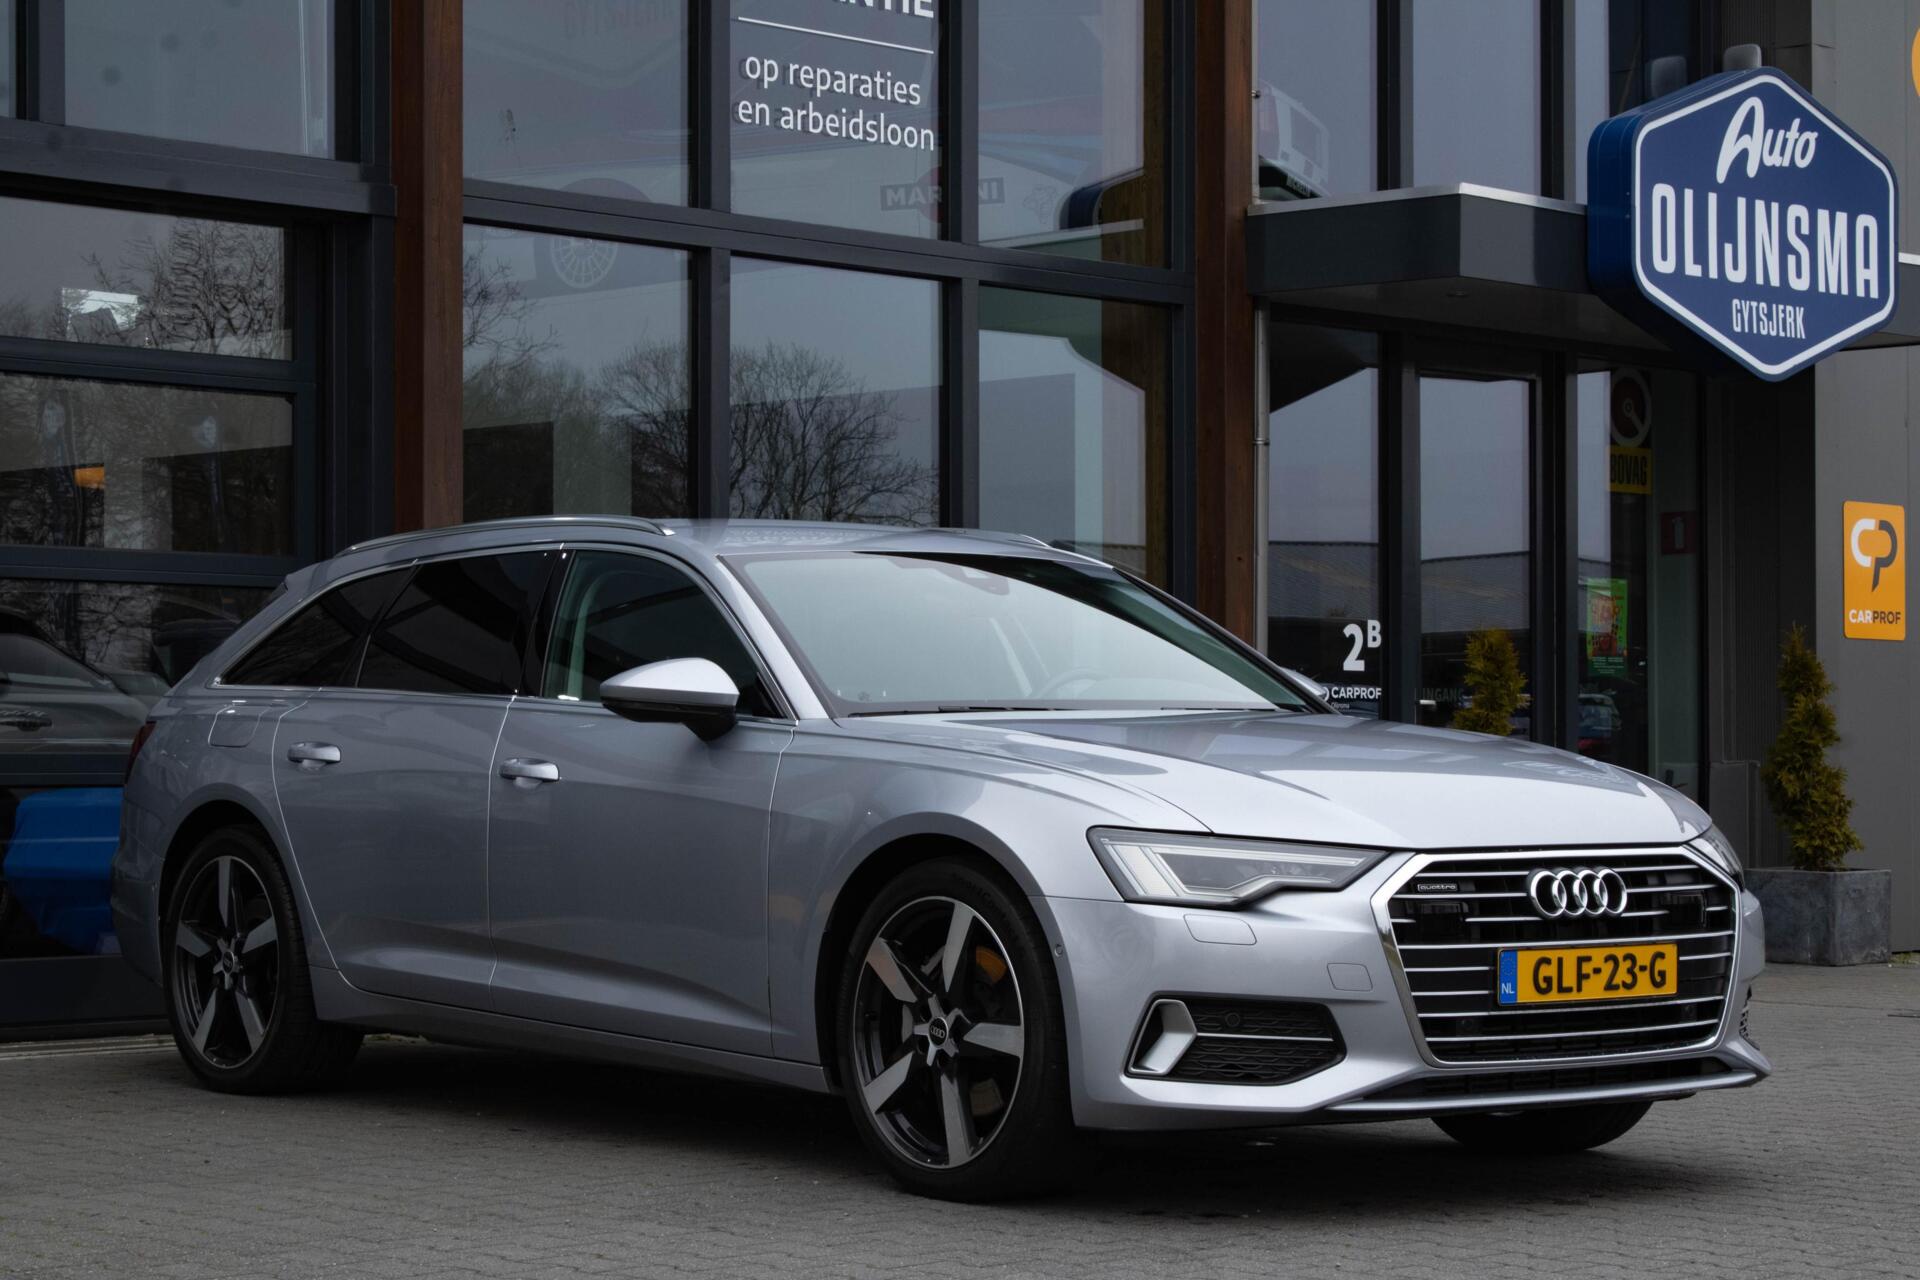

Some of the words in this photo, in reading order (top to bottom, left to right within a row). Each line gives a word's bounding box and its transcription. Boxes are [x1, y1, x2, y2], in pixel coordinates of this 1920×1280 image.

[745, 56, 779, 89] op
[789, 63, 921, 105] reparaties
[738, 100, 770, 126] en
[780, 101, 934, 151] arbeidsloon
[1716, 96, 1818, 184] Auto
[1652, 183, 1879, 299] OLIJNSMA
[1731, 299, 1806, 339] GYTSJERK
[1610, 454, 1648, 486] BOVAG
[1848, 608, 1902, 625] CARPROF
[1331, 686, 1382, 700] CARPROF
[1501, 983, 1515, 994] NL
[1533, 952, 1667, 995] GLF-23-G
